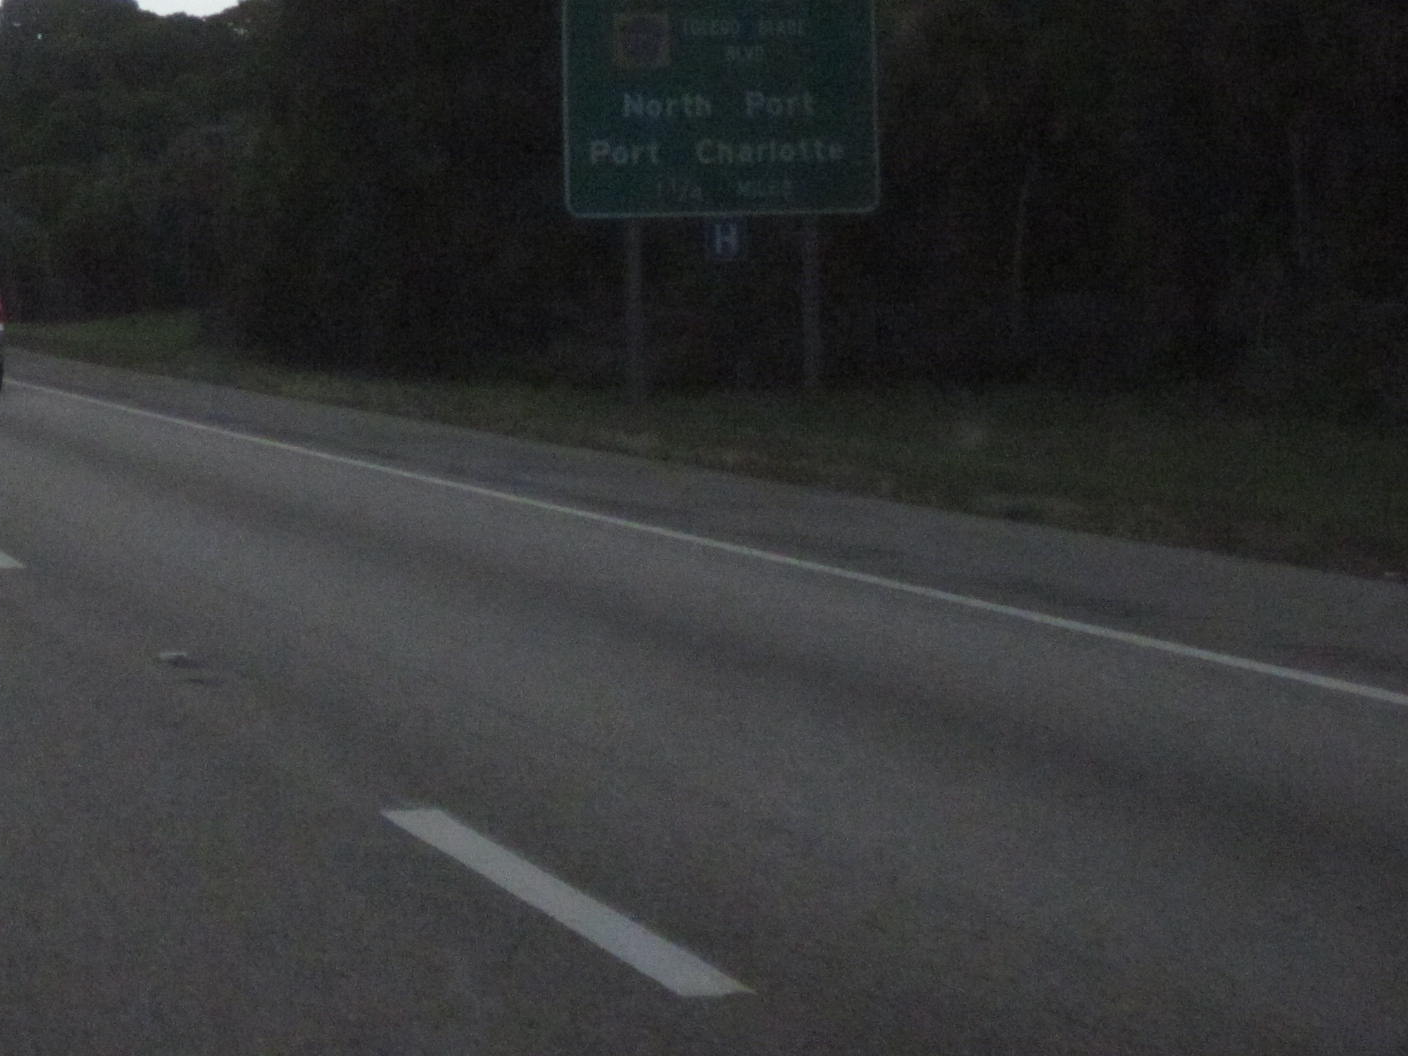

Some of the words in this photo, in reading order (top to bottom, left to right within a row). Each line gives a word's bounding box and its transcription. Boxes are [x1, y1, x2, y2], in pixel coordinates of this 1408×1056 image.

[622, 91, 713, 118] North
[744, 90, 816, 119] Port
[590, 139, 660, 165] Port
[696, 139, 845, 165] Charlotte
